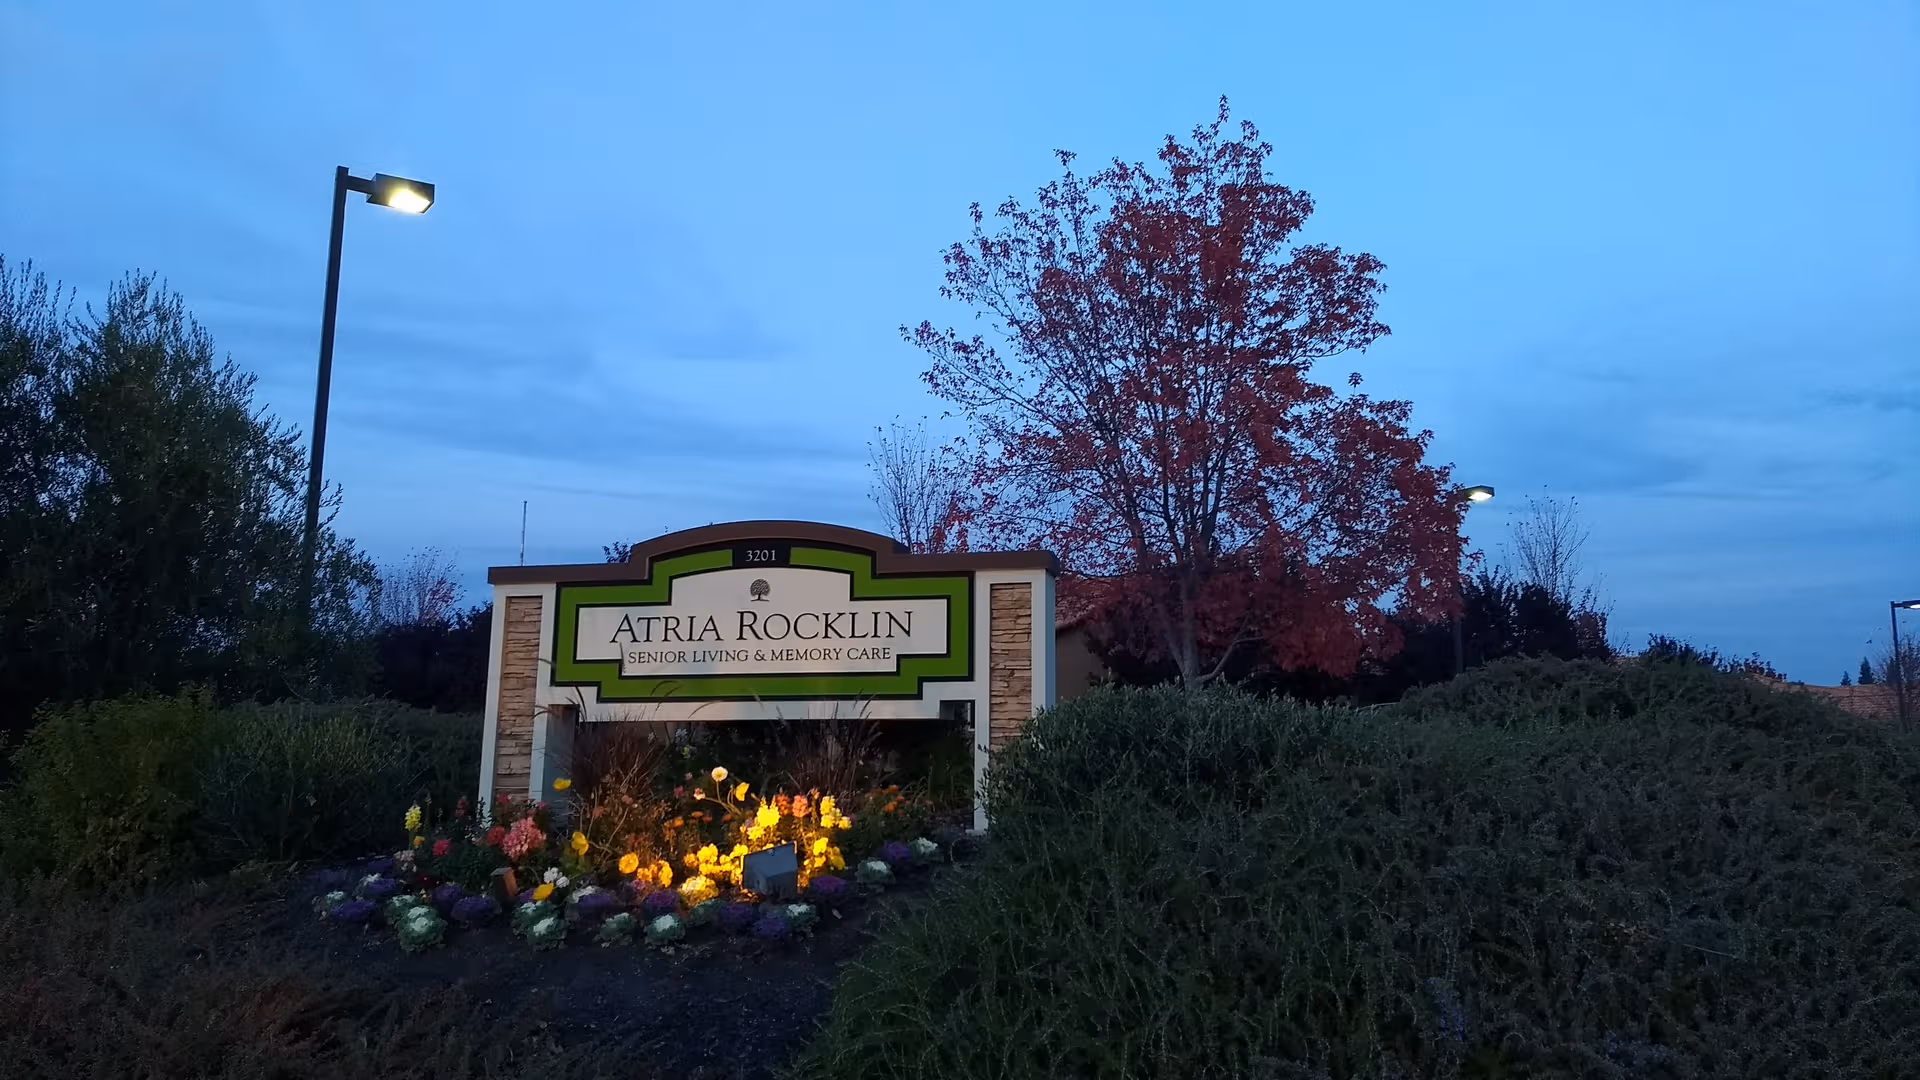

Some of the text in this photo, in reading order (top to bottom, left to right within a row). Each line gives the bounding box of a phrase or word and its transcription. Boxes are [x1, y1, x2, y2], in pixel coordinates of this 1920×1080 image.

[745, 549, 777, 562] 3201
[609, 610, 914, 644] ATRIA ROCKLIN
[628, 647, 891, 665] SENIOR LIVING & MEMORY CARE
